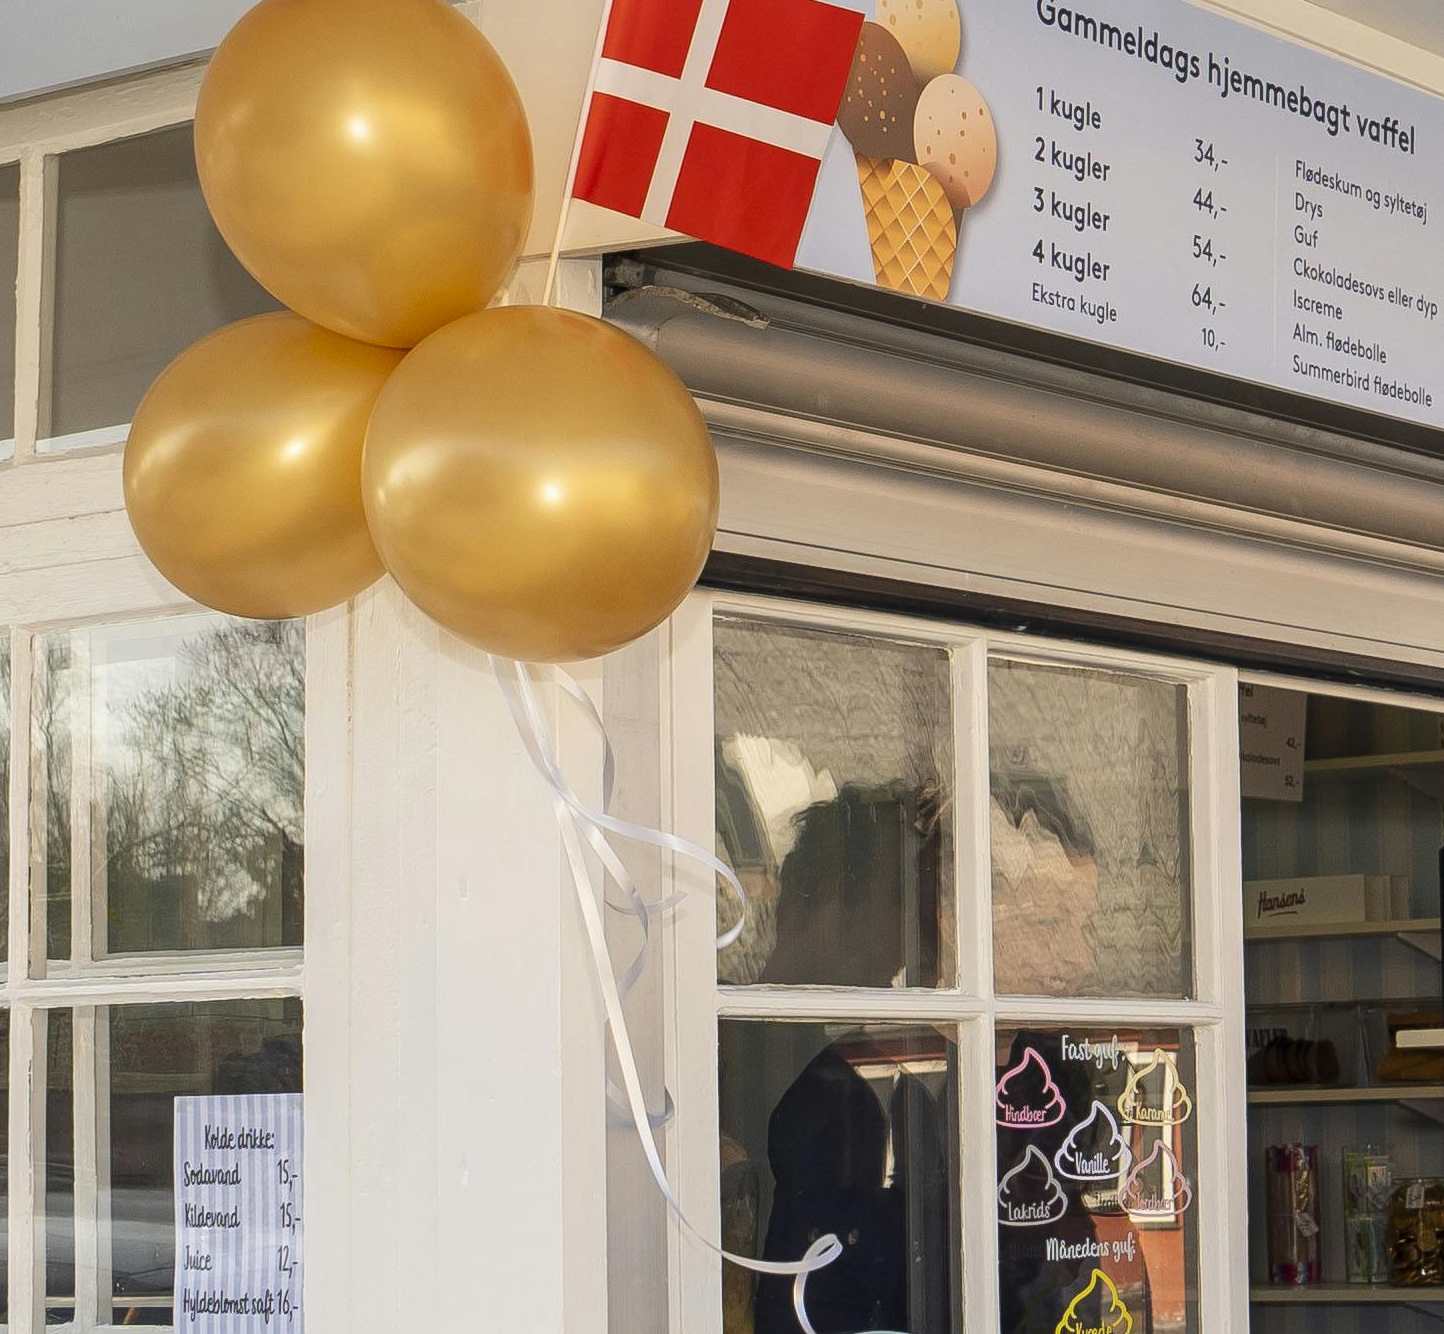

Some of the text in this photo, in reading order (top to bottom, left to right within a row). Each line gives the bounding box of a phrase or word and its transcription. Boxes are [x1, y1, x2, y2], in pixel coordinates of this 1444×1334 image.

[1209, 53, 1350, 136] hjemmebagt
[1356, 115, 1414, 154] vaffel
[1037, 87, 1228, 171] 1 kugle 34,-
[1035, 137, 1226, 219] 2 kugler 44,-
[1296, 160, 1361, 198] Flødeskum
[1366, 189, 1380, 209] og
[1384, 193, 1426, 225] syltetøj
[1034, 187, 1226, 267] 3 kugler 54,-
[1033, 239, 1225, 315] 4 kugler 64,-
[1294, 258, 1384, 300] Ckokoladesovs
[1388, 287, 1413, 307] eller
[1416, 299, 1438, 320] dyp
[1032, 283, 1225, 351] Ekstra kugle 10,-
[1294, 289, 1342, 319] Iscreme
[1293, 323, 1322, 347] Alm.
[1326, 331, 1386, 363] flødebolle
[1293, 355, 1369, 390] Summerbird
[1374, 376, 1432, 407] flødebolle
[1258, 888, 1305, 918] Hansens
[1062, 1035, 1092, 1060] Fast
[1005, 1104, 1047, 1121] Hindbær
[205, 1125, 274, 1149] Kolde drikke:
[184, 1160, 298, 1191] Sodavand 15,-
[1075, 1152, 1109, 1174] Vanille
[185, 1203, 300, 1233] Kildevand 15,-
[1008, 1202, 1050, 1221] Lakrids
[184, 1245, 298, 1277] Juice 12,-
[1046, 1238, 1109, 1260] Månedens
[184, 1290, 298, 1324] Hyldeblomst saft 16,-
